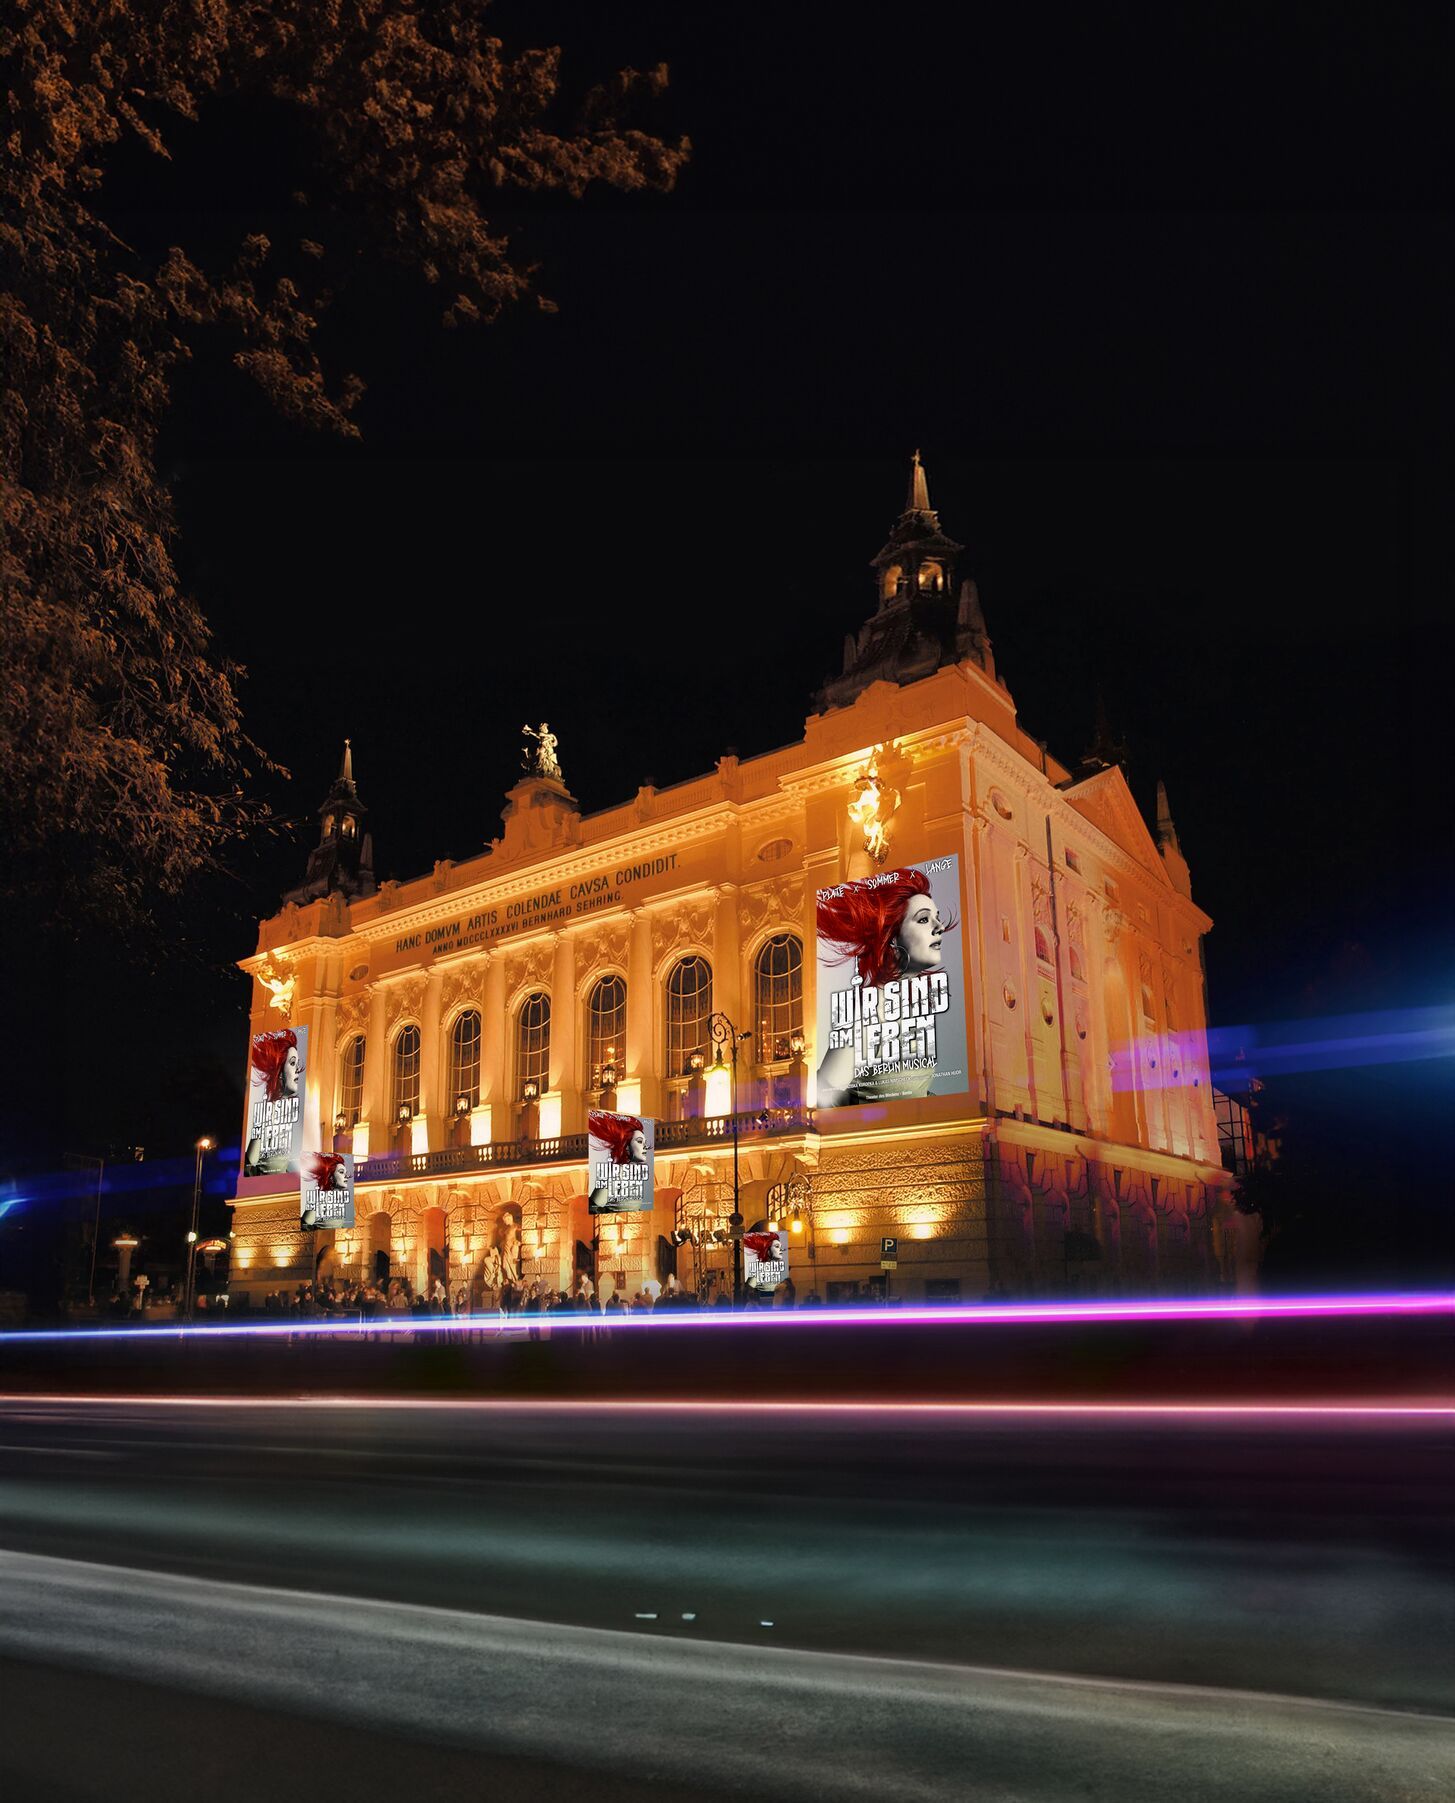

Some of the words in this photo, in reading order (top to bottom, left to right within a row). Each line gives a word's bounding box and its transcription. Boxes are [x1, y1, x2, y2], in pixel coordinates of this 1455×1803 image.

[867, 872, 899, 889] SOMMER
[925, 858, 952, 875] LANGE
[396, 935, 421, 952] HANC
[425, 922, 460, 944] DOMVM
[467, 910, 498, 931] ARTIS
[507, 890, 561, 919] COLENDAE
[570, 876, 609, 899] CAVSA
[433, 943, 453, 955] ANNO
[522, 906, 572, 928] BERNHARD
[830, 975, 879, 1030] WIR
[883, 972, 950, 1021] SIND
[829, 1028, 854, 1050] AM
[854, 1014, 938, 1068] LEBEN
[854, 1065, 870, 1078] DAS
[872, 1058, 900, 1076] BERLIN
[902, 1055, 938, 1071] MUSICAL
[253, 1094, 273, 1128] WIR
[274, 1097, 299, 1125] SIND
[260, 1122, 293, 1151] LEBEN
[596, 1158, 620, 1181] WIR
[621, 1163, 649, 1181] SIND
[306, 1187, 326, 1204] WIR
[326, 1190, 350, 1204] SIND
[608, 1180, 643, 1197] LEBEN
[315, 1203, 346, 1218] LEBEN
[884, 1239, 895, 1252] P
[749, 1259, 764, 1274] WIR
[764, 1260, 785, 1273] SIND
